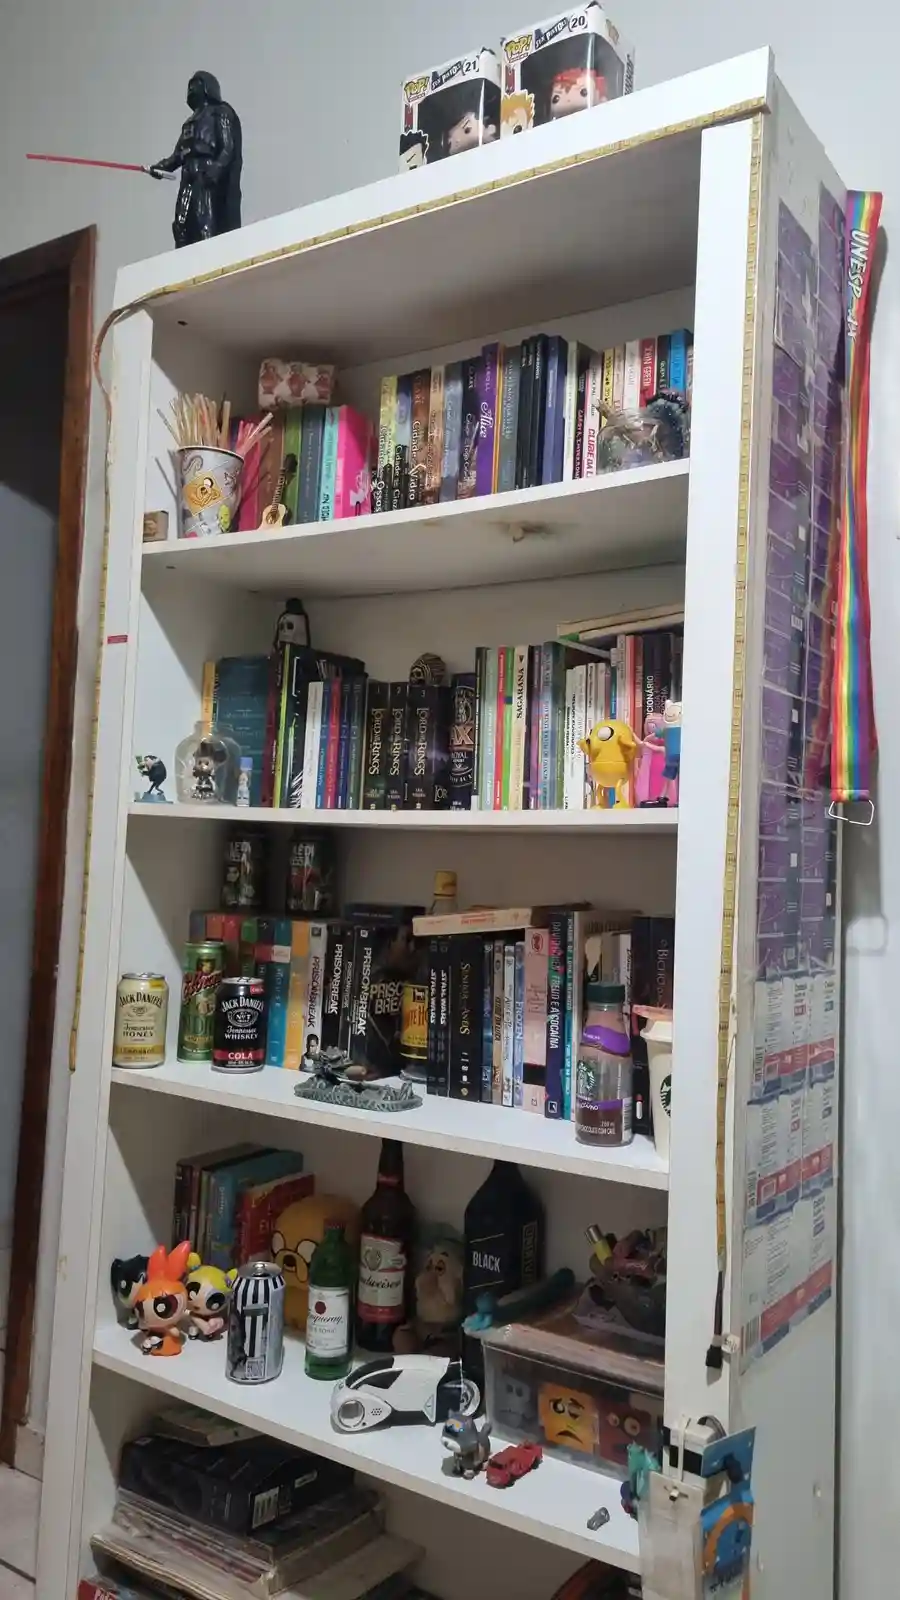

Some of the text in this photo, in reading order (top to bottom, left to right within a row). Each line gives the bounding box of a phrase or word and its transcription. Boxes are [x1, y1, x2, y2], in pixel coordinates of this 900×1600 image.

[848, 229, 870, 299] UNESP
[480, 402, 494, 438] Alice
[586, 428, 596, 458] CLUBE
[394, 446, 403, 476] Cidade
[376, 481, 384, 512] Ossos
[409, 471, 418, 501] Vidro
[516, 668, 525, 719] SAGARANA
[372, 708, 387, 733] LORD
[414, 708, 429, 776] LORD RINGS
[368, 742, 382, 775] RINGS
[390, 742, 402, 776] RINGS
[434, 785, 448, 802] LOR
[120, 994, 136, 1007] JACK
[370, 981, 404, 1000] PRISO
[551, 975, 562, 1000] FREUD
[221, 1000, 239, 1013] JACK
[429, 996, 437, 1025] WARS
[515, 1001, 524, 1040] FROZEN
[549, 1014, 561, 1049] COCAÍNA
[228, 1052, 253, 1060] COLA
[472, 1251, 501, 1273] BLACK
